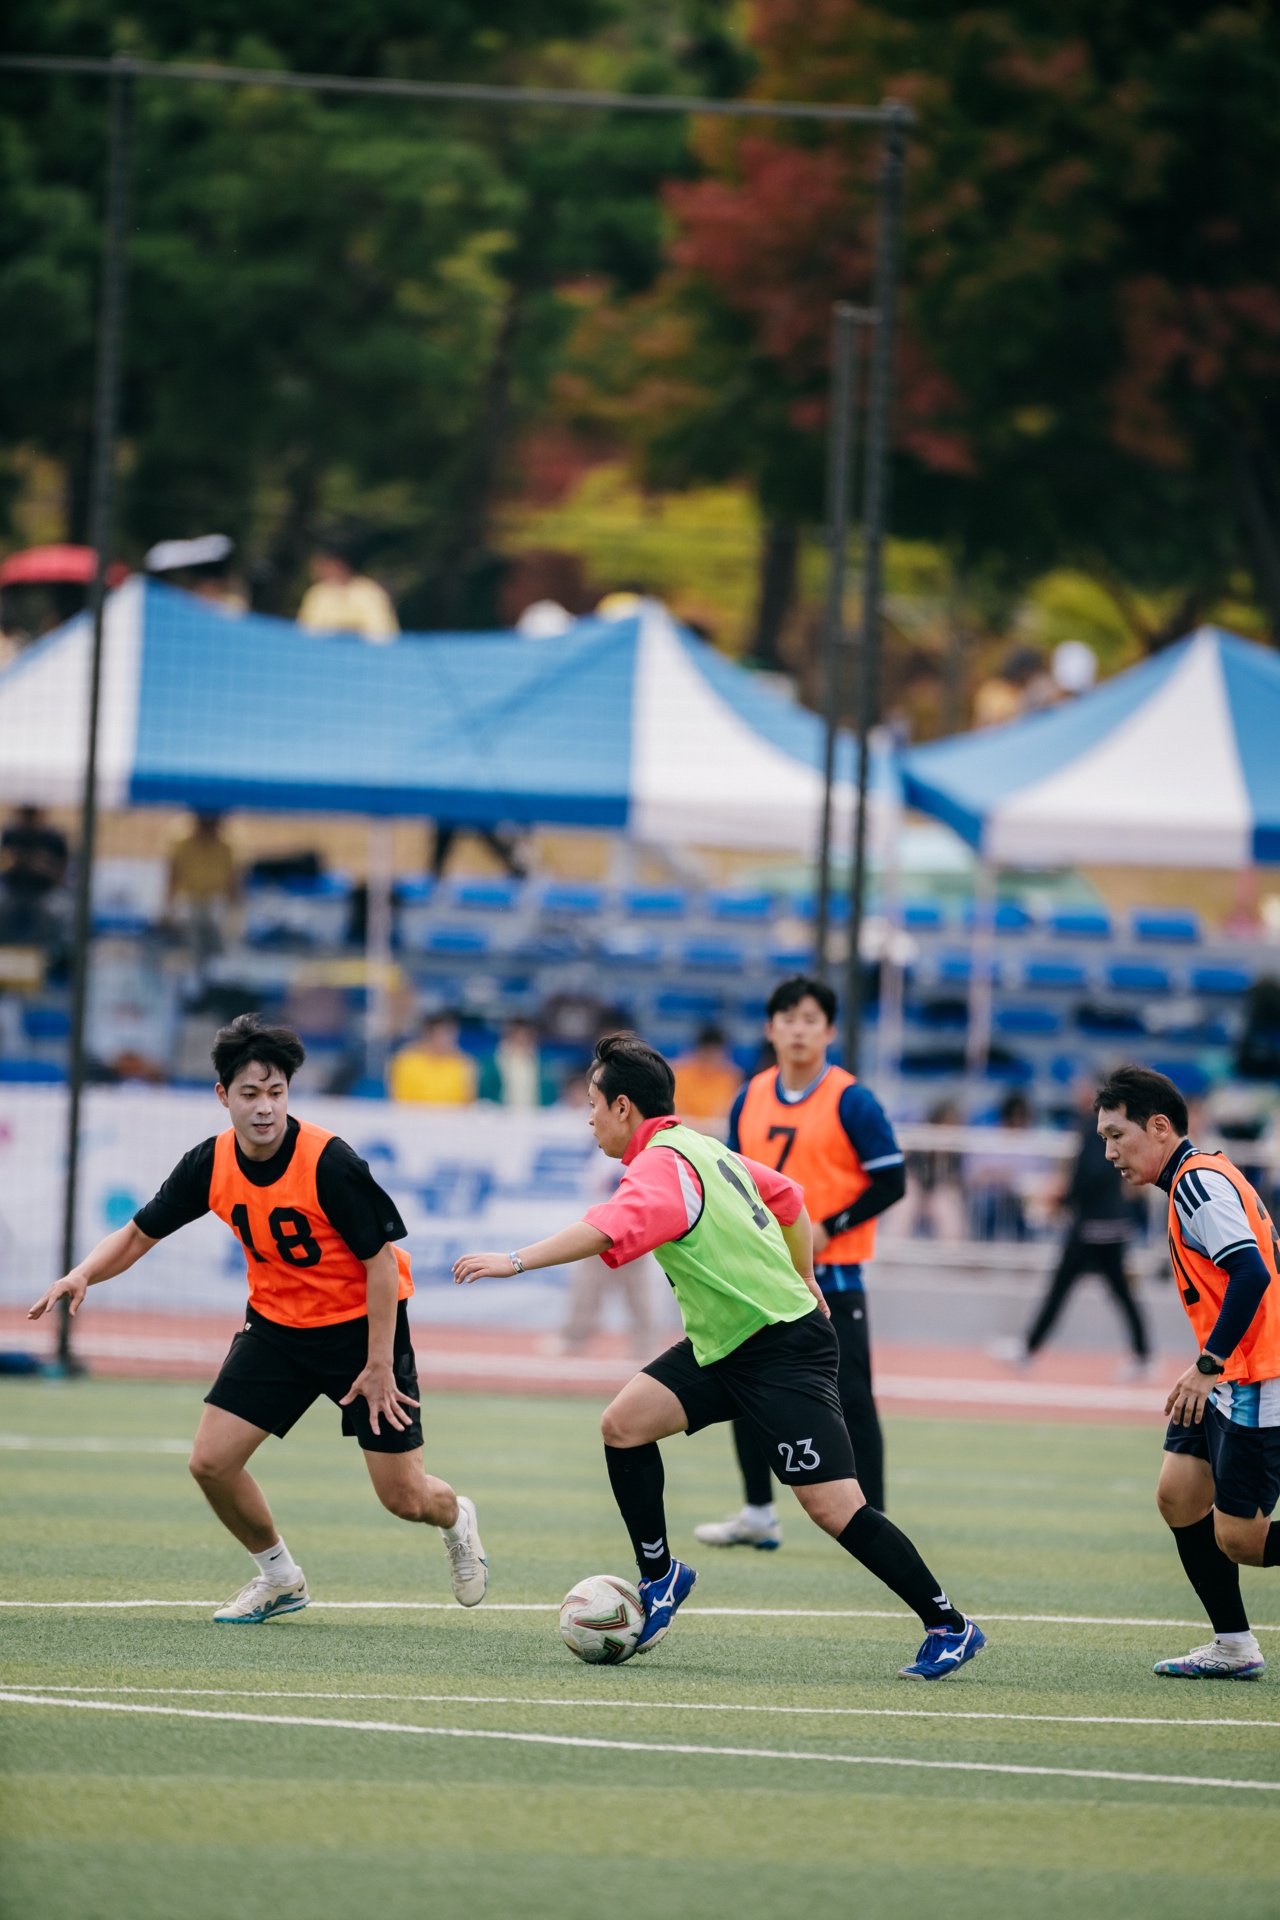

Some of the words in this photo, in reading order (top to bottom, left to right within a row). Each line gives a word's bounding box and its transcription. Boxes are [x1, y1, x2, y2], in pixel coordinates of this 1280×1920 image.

[767, 1126, 797, 1174] 7
[231, 1203, 323, 1268] 18
[777, 1438, 821, 1472] 23
